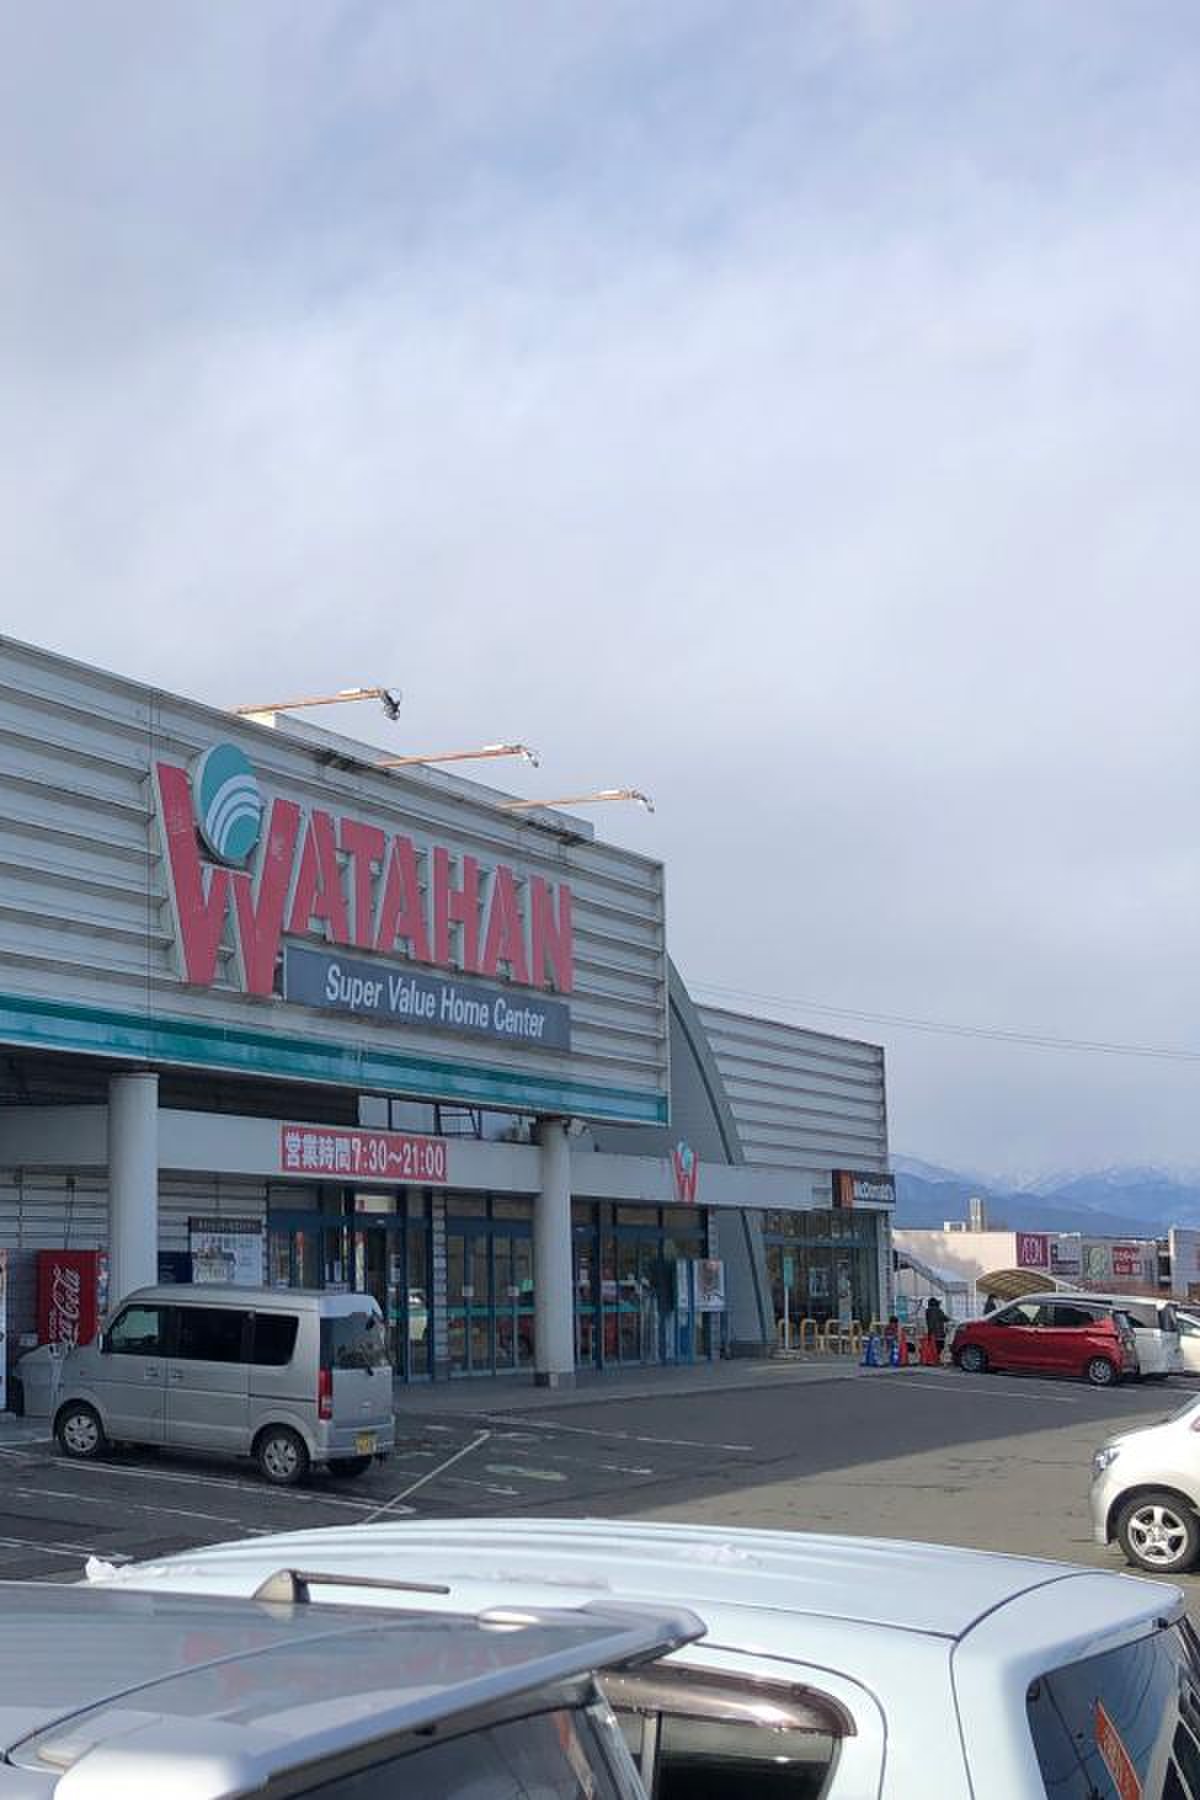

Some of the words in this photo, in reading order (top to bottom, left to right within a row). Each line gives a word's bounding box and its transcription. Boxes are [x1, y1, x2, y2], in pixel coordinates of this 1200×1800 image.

[156, 761, 574, 998] WATAHAN
[325, 964, 383, 1009] Super
[388, 975, 435, 1017] Value
[441, 985, 489, 1028] Home
[494, 997, 545, 1038] Center
